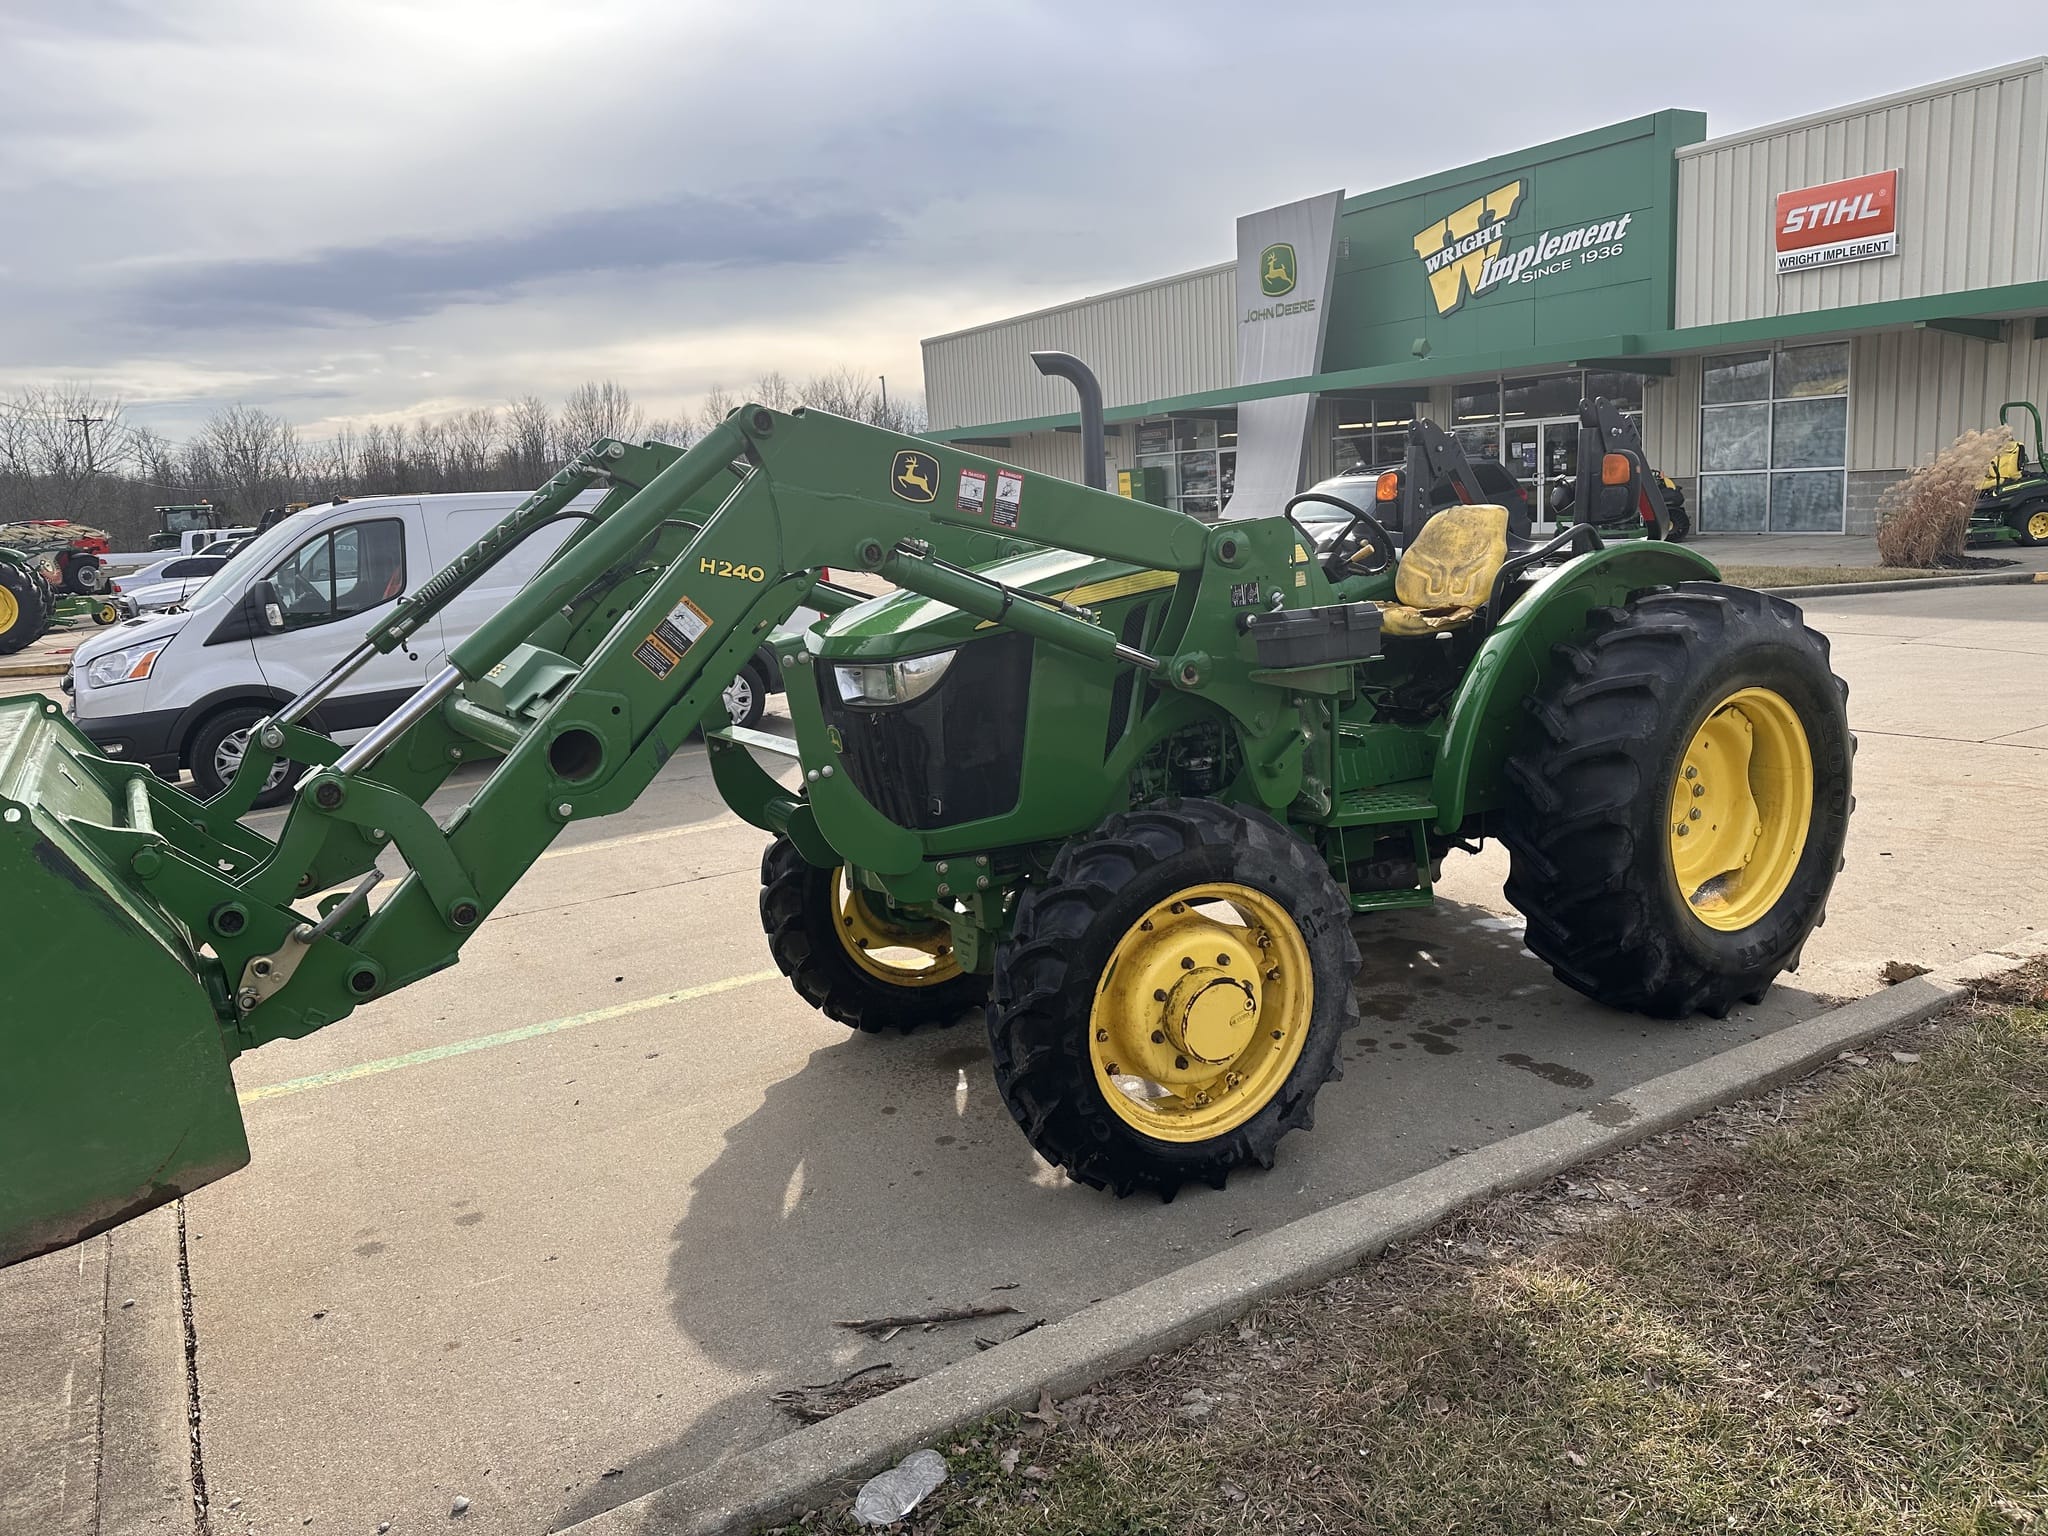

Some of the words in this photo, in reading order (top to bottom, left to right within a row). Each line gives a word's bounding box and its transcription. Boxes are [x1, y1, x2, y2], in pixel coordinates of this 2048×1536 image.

[1782, 193, 1882, 234] STIHL
[1424, 220, 1506, 274] WRIGHT
[1476, 212, 1632, 292] Implement
[1521, 259, 1572, 284] SINCE
[1579, 243, 1623, 265] 1936
[1778, 251, 1821, 268] WRIGHT
[1823, 240, 1889, 260] IMPLEMENT
[1244, 306, 1274, 323] JOHN
[1276, 299, 1316, 318] DEERE
